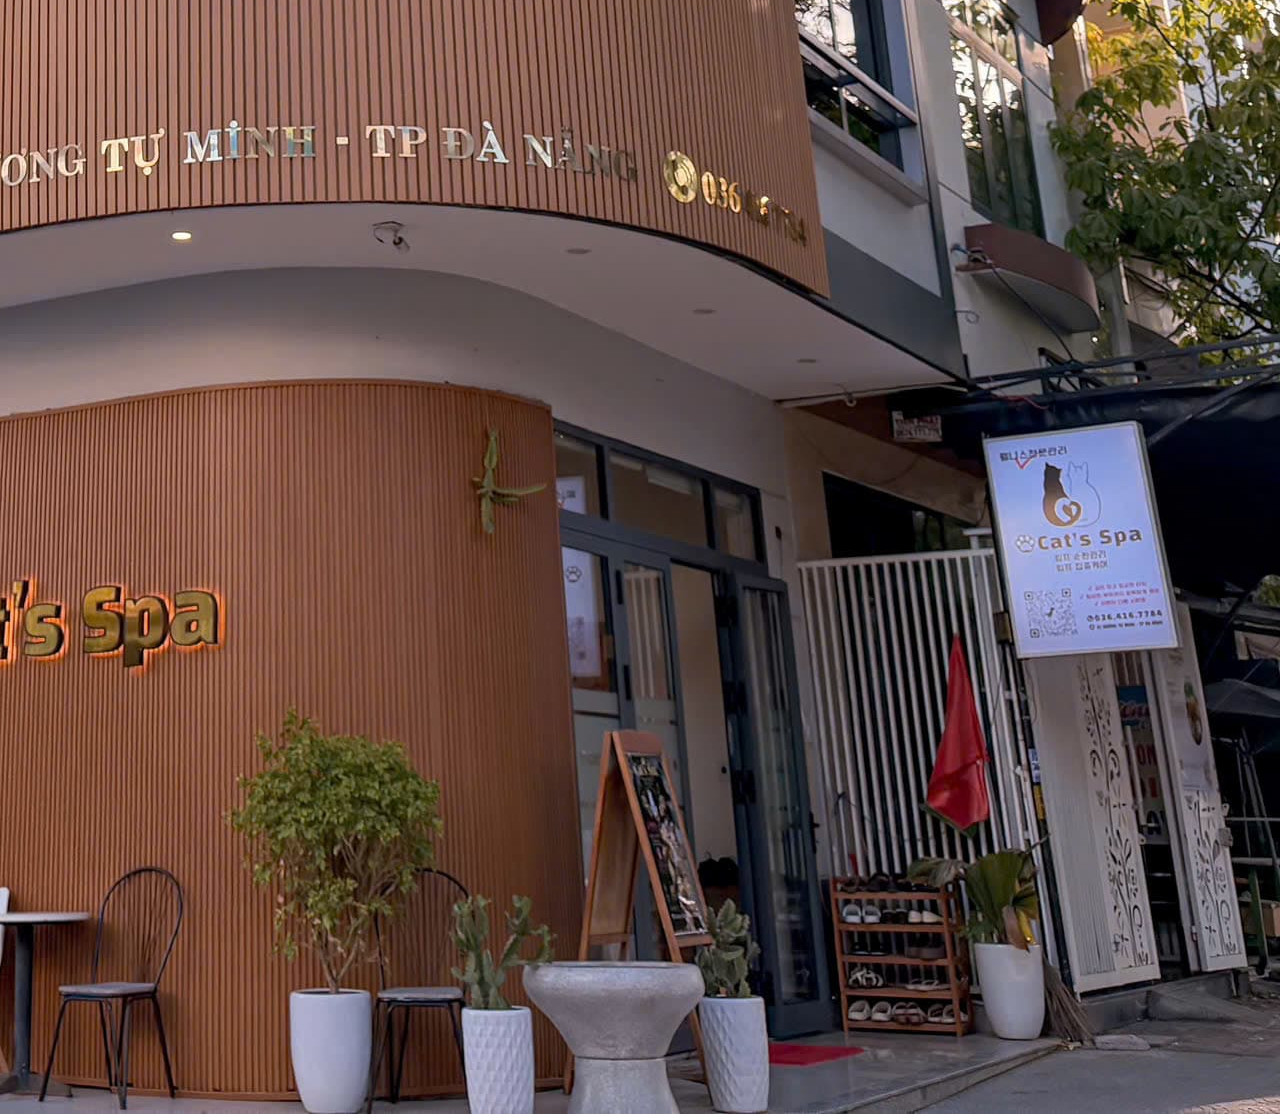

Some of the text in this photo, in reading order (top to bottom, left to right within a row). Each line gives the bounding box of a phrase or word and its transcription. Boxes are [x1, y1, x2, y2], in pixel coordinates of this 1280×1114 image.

[101, 127, 165, 176] TỰ
[365, 125, 427, 158] TP
[441, 121, 510, 164] ĐÀ
[1038, 529, 1142, 550] Cat's Spa
[83, 584, 219, 668] Spa
